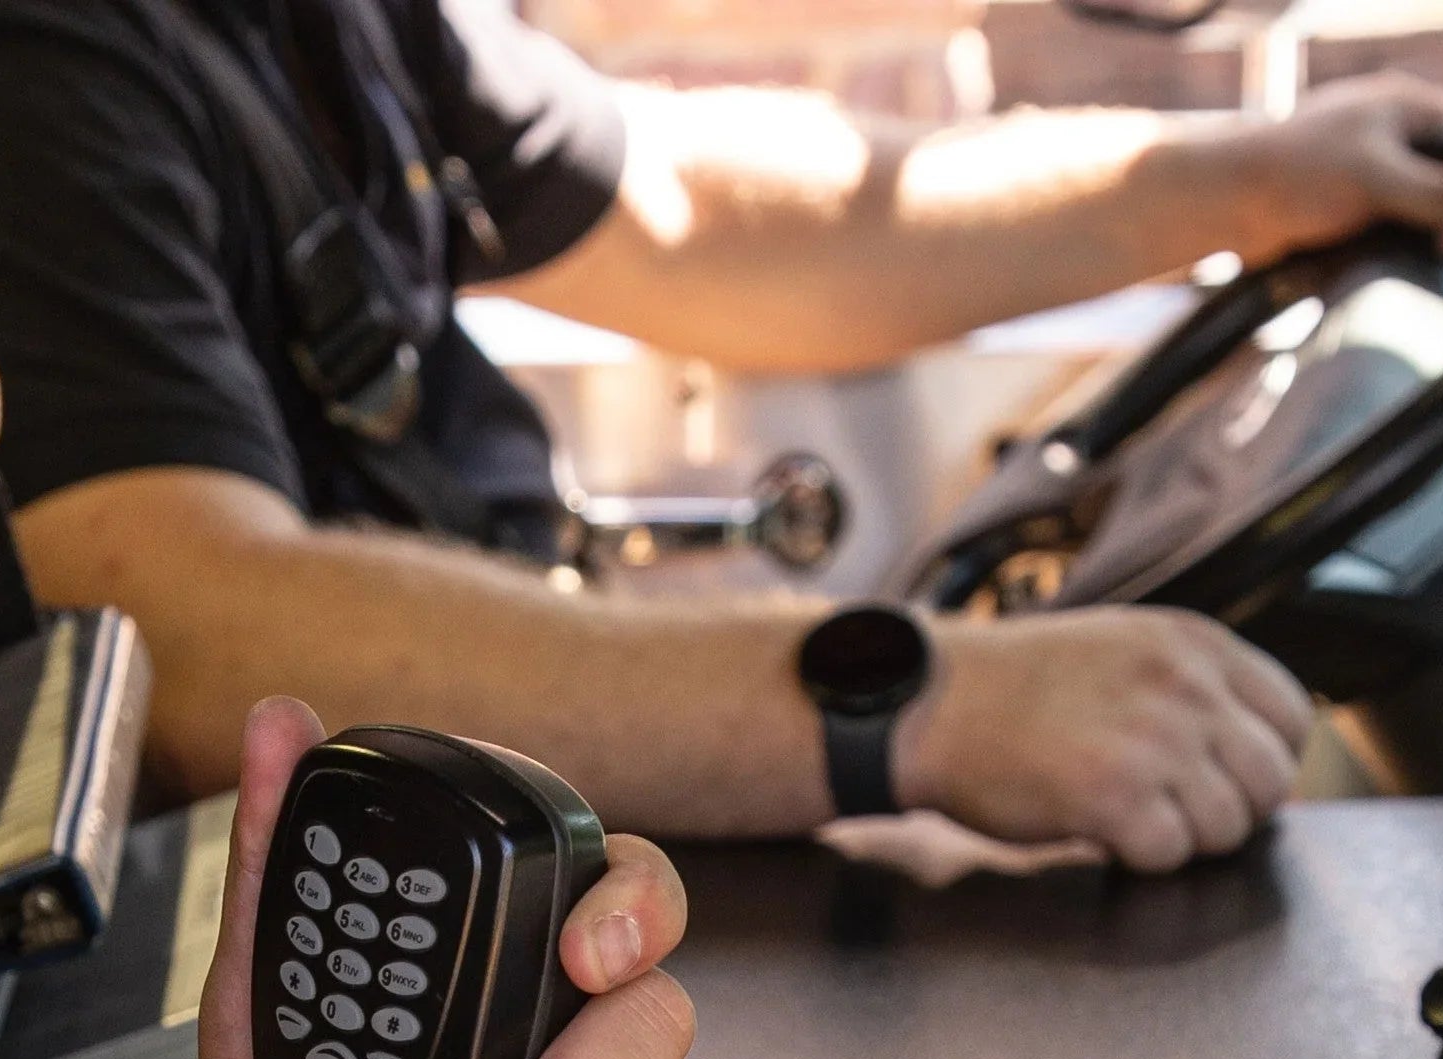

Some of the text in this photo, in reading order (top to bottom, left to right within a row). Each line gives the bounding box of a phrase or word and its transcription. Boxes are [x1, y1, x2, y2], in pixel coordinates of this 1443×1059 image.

[309, 831, 317, 851] 1
[349, 862, 379, 886] 2 ABC
[297, 876, 306, 895] 4
[400, 875, 432, 896] 3 DEF
[339, 909, 350, 928] 5
[290, 920, 316, 950] 7 PQRS
[391, 922, 424, 944] 6 MNO
[332, 954, 359, 977] 8 TUV
[381, 967, 419, 990] 9 WXYZ
[326, 1000, 336, 1019] 0
